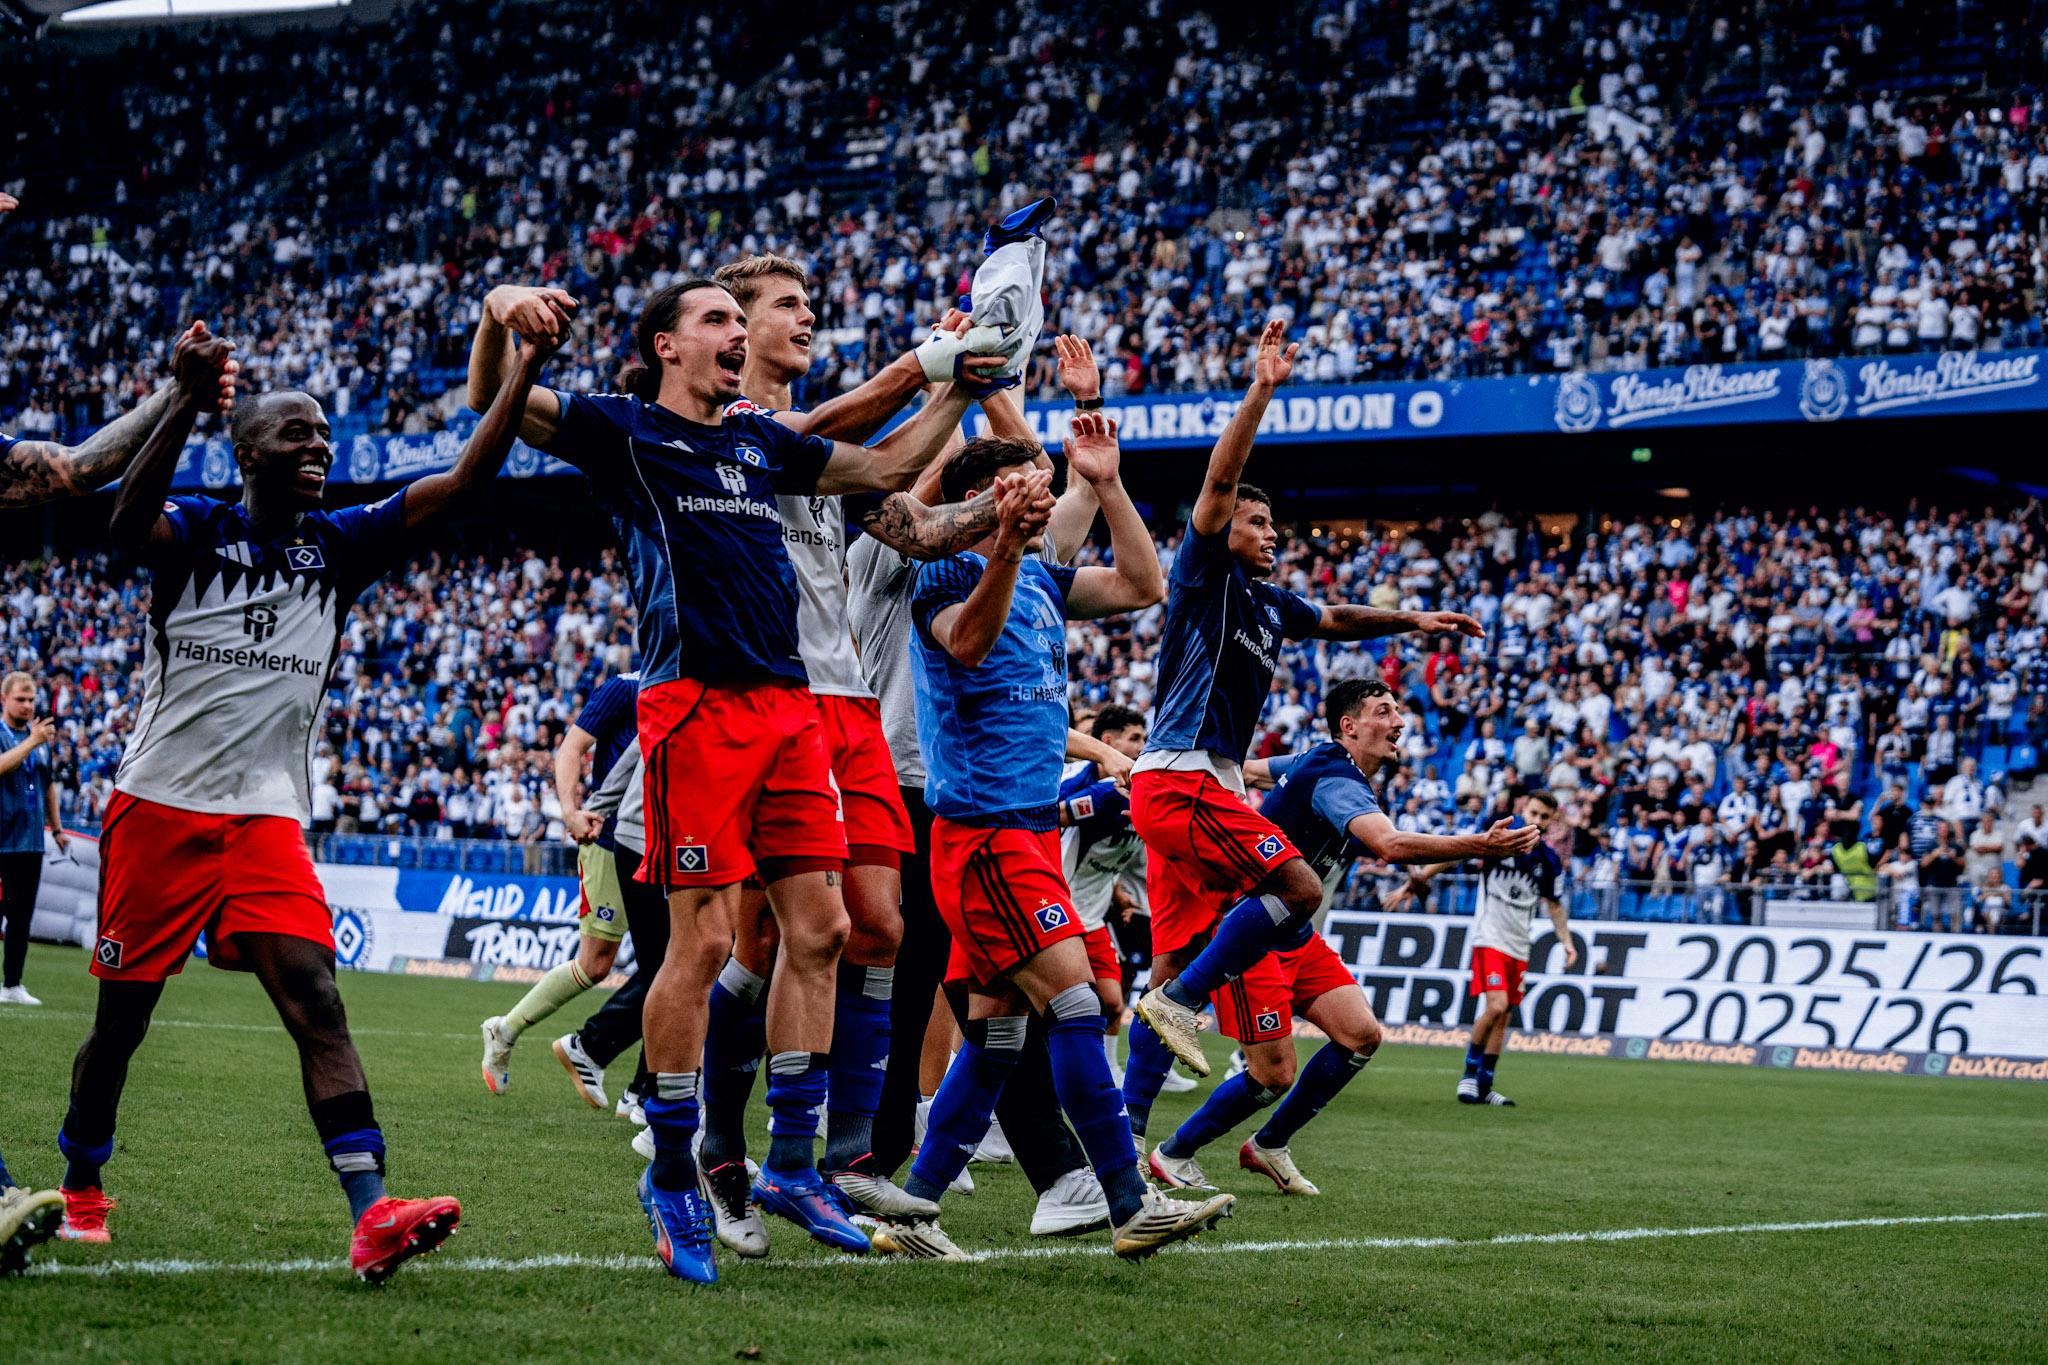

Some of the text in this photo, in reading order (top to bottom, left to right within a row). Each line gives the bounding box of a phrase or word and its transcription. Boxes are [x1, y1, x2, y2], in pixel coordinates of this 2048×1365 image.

[1683, 363, 1781, 402] Pilsener
[1936, 350, 2040, 391] Pilsener
[175, 640, 322, 676] HanseMerkur
[1330, 921, 2041, 995] TRIOT 2025/26
[1660, 987, 1973, 1052] 2025/26
[1647, 1040, 1757, 1065] buXtrade
[1794, 1047, 1908, 1073] buXtrade
[1947, 1056, 2048, 1081] buXtrad
